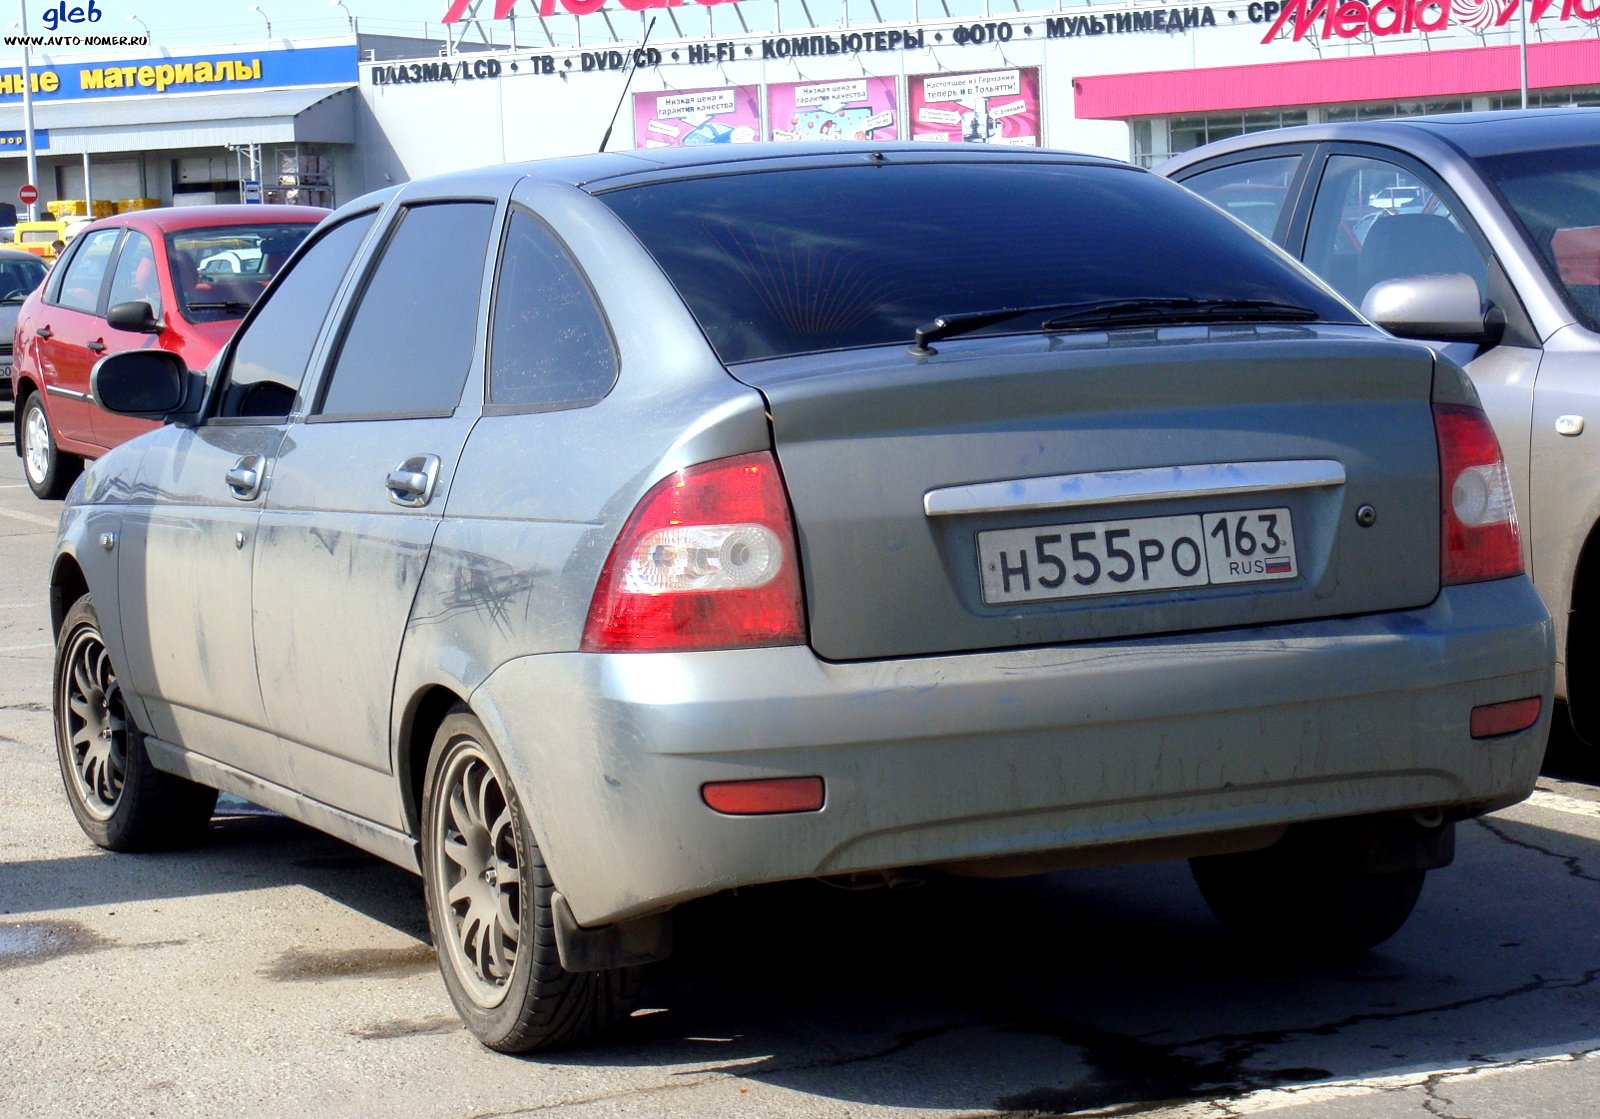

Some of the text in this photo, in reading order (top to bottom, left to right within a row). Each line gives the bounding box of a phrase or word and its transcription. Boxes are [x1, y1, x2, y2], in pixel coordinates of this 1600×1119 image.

[531, 55, 555, 75] ТВ
[581, 48, 662, 72] DVD/CD
[689, 42, 735, 64] Hi-Fi
[762, 29, 924, 58] КОМПЬЮТЕРЫ
[953, 22, 1013, 45] ФОТО
[1046, 6, 1216, 38] МУЛЬТИМЕДИА
[80, 59, 261, 92] материалы
[926, 80, 966, 88] Настоящее
[978, 75, 1015, 84] Германии
[832, 92, 866, 100] качества
[928, 90, 958, 98] теперь
[975, 82, 1016, 94] Тольятти!
[665, 97, 695, 105] Низкая
[697, 95, 717, 103] цена
[658, 102, 734, 115] гарантия качества
[1211, 514, 1281, 558] 163
[1230, 561, 1264, 576] RUS
